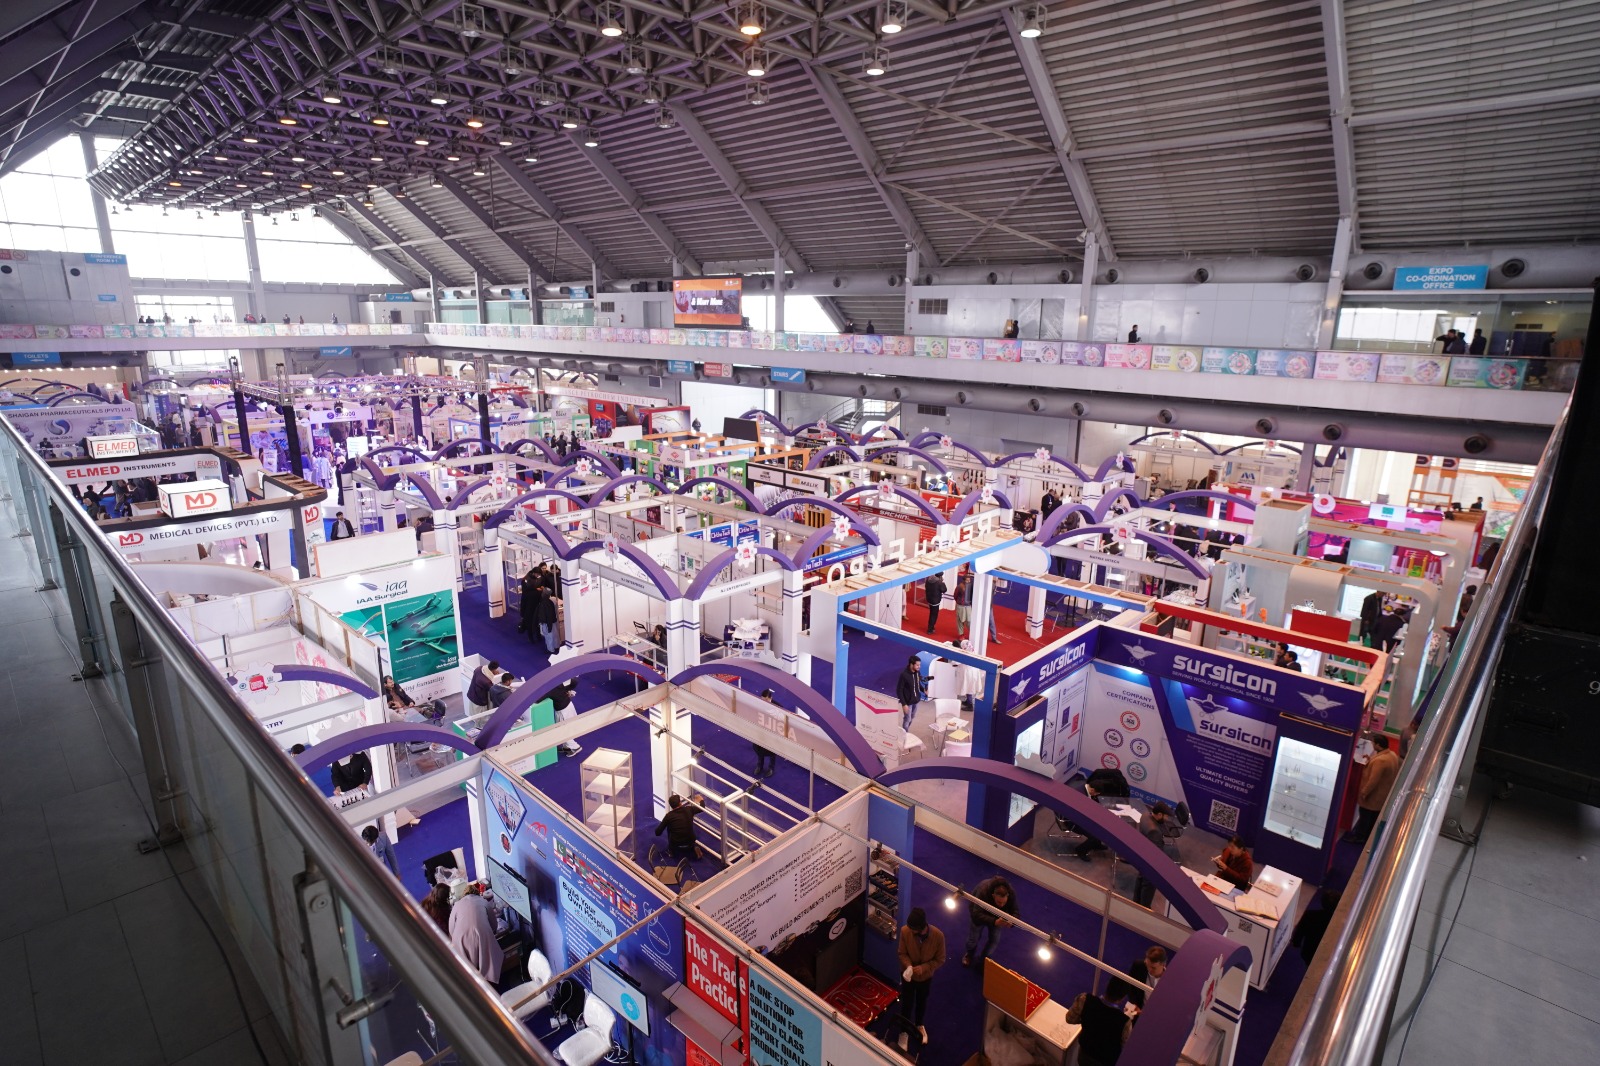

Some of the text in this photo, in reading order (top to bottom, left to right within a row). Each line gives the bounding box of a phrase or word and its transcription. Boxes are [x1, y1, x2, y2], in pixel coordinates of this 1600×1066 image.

[1406, 274, 1476, 282] CO-ORDINATION
[40, 408, 103, 417] PHARMACEUTICALS
[96, 441, 136, 452] ELMED
[66, 461, 177, 479] ELMED INSTRUMENTS
[184, 492, 217, 510] MD
[304, 506, 319, 523] MD
[119, 532, 144, 546] MD
[150, 516, 279, 541] MEDICAL DEVICES (PVT.) LTD.
[374, 589, 408, 600] Surgical
[386, 580, 407, 592] iaa
[1172, 670, 1192, 680] SERVING
[1194, 676, 1211, 686] WORLD
[1220, 683, 1244, 695] SURGICAL
[1246, 691, 1261, 700] SINCE
[1106, 691, 1155, 710] CERTIFICATIONS
[1122, 690, 1152, 702] COMPANY
[1196, 766, 1222, 779] ULTIMATE
[1223, 775, 1245, 787] CHOICE
[1199, 773, 1224, 786] QUALITY
[1224, 782, 1249, 794] BUYERS
[718, 898, 739, 915] Present
[766, 856, 800, 882] INSTRUMENT
[563, 882, 580, 900] Build
[581, 897, 596, 915] Your
[739, 900, 759, 916] Surgery
[568, 893, 583, 911] Own
[584, 909, 612, 938] Hospital
[770, 932, 778, 940] WE
[779, 920, 793, 934] BUILD
[794, 896, 824, 923] INSTRUMENTS
[832, 883, 842, 894] HEAL
[685, 929, 708, 966] The
[709, 946, 746, 997] Trade
[750, 979, 794, 1017] A ONE STOP
[750, 992, 804, 1040] SOLUTION FOR
[750, 1005, 805, 1055] WORLD CLASS
[750, 1019, 779, 1048] EXPORT
[751, 1032, 789, 1066] PRODUCTS
